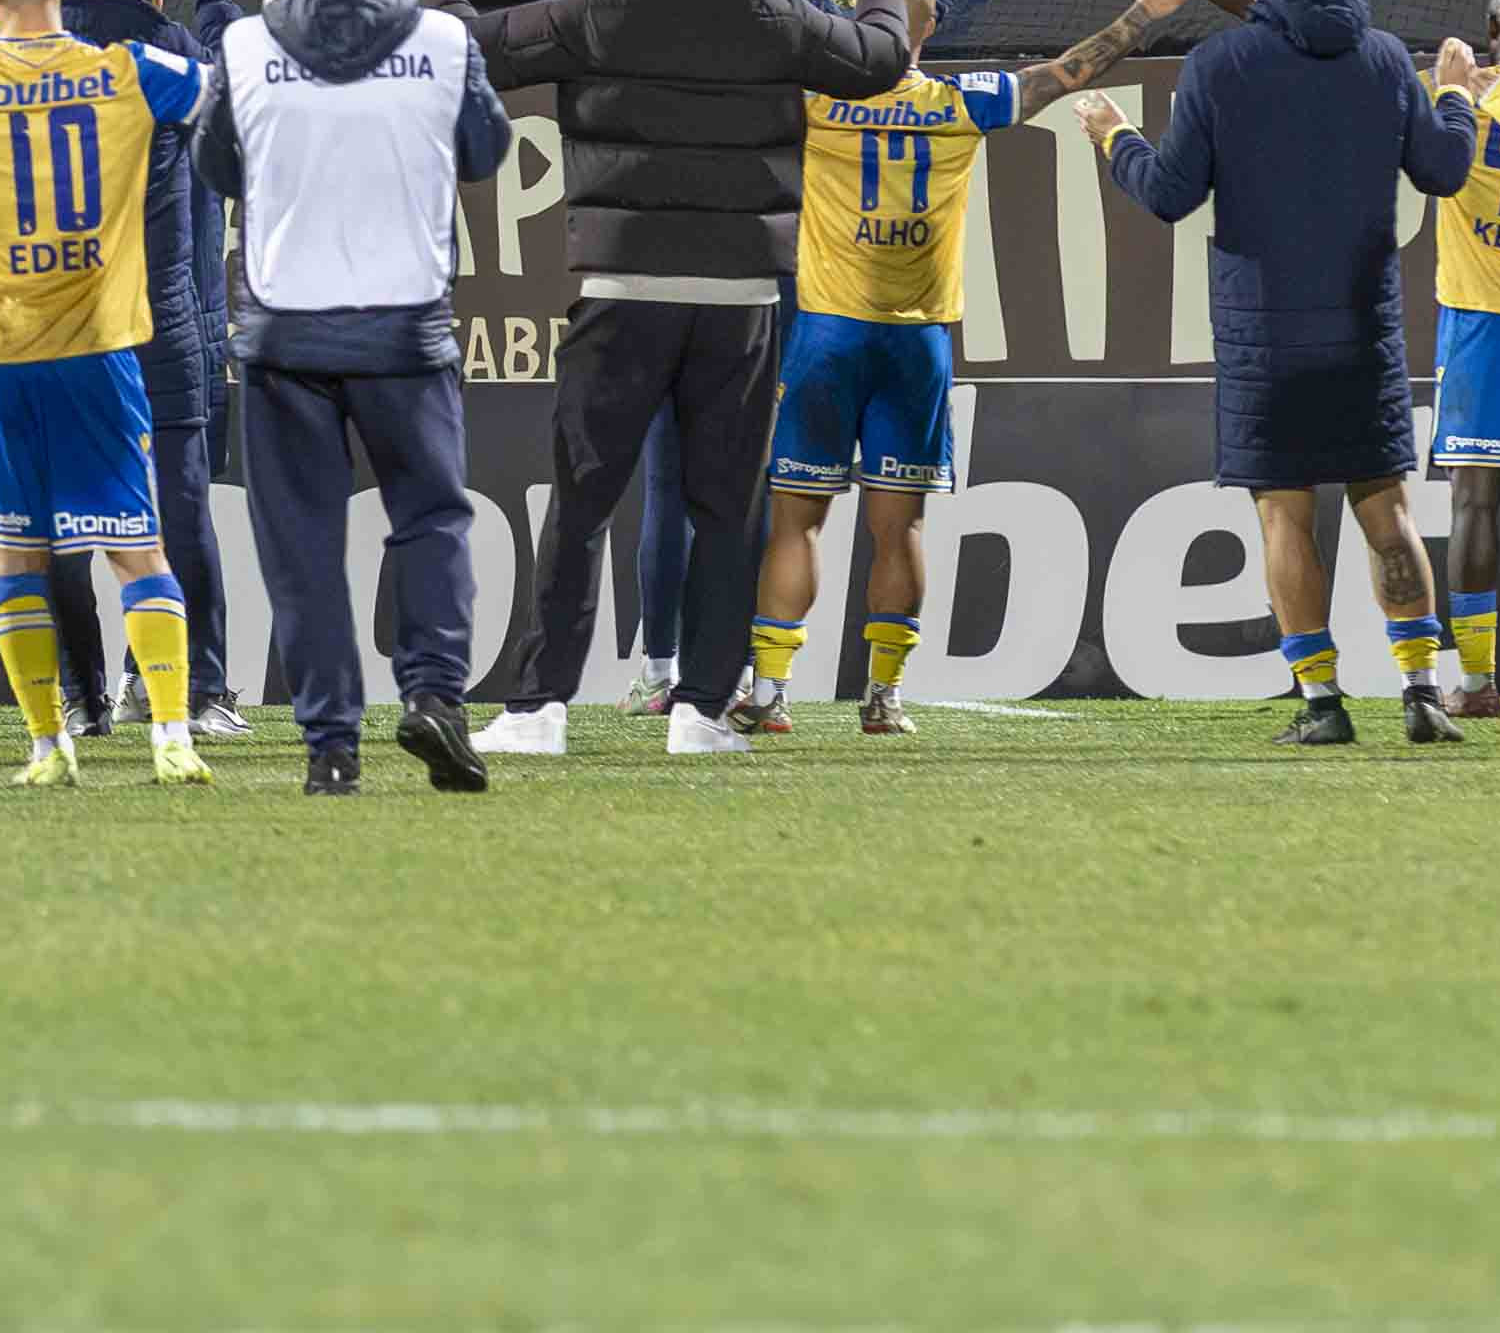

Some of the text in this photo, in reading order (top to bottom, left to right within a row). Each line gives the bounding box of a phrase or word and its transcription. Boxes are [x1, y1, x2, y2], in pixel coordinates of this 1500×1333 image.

[8, 103, 102, 236] 10
[854, 219, 931, 248] ALHO
[9, 237, 104, 276] EDER
[54, 511, 148, 537] Promist
